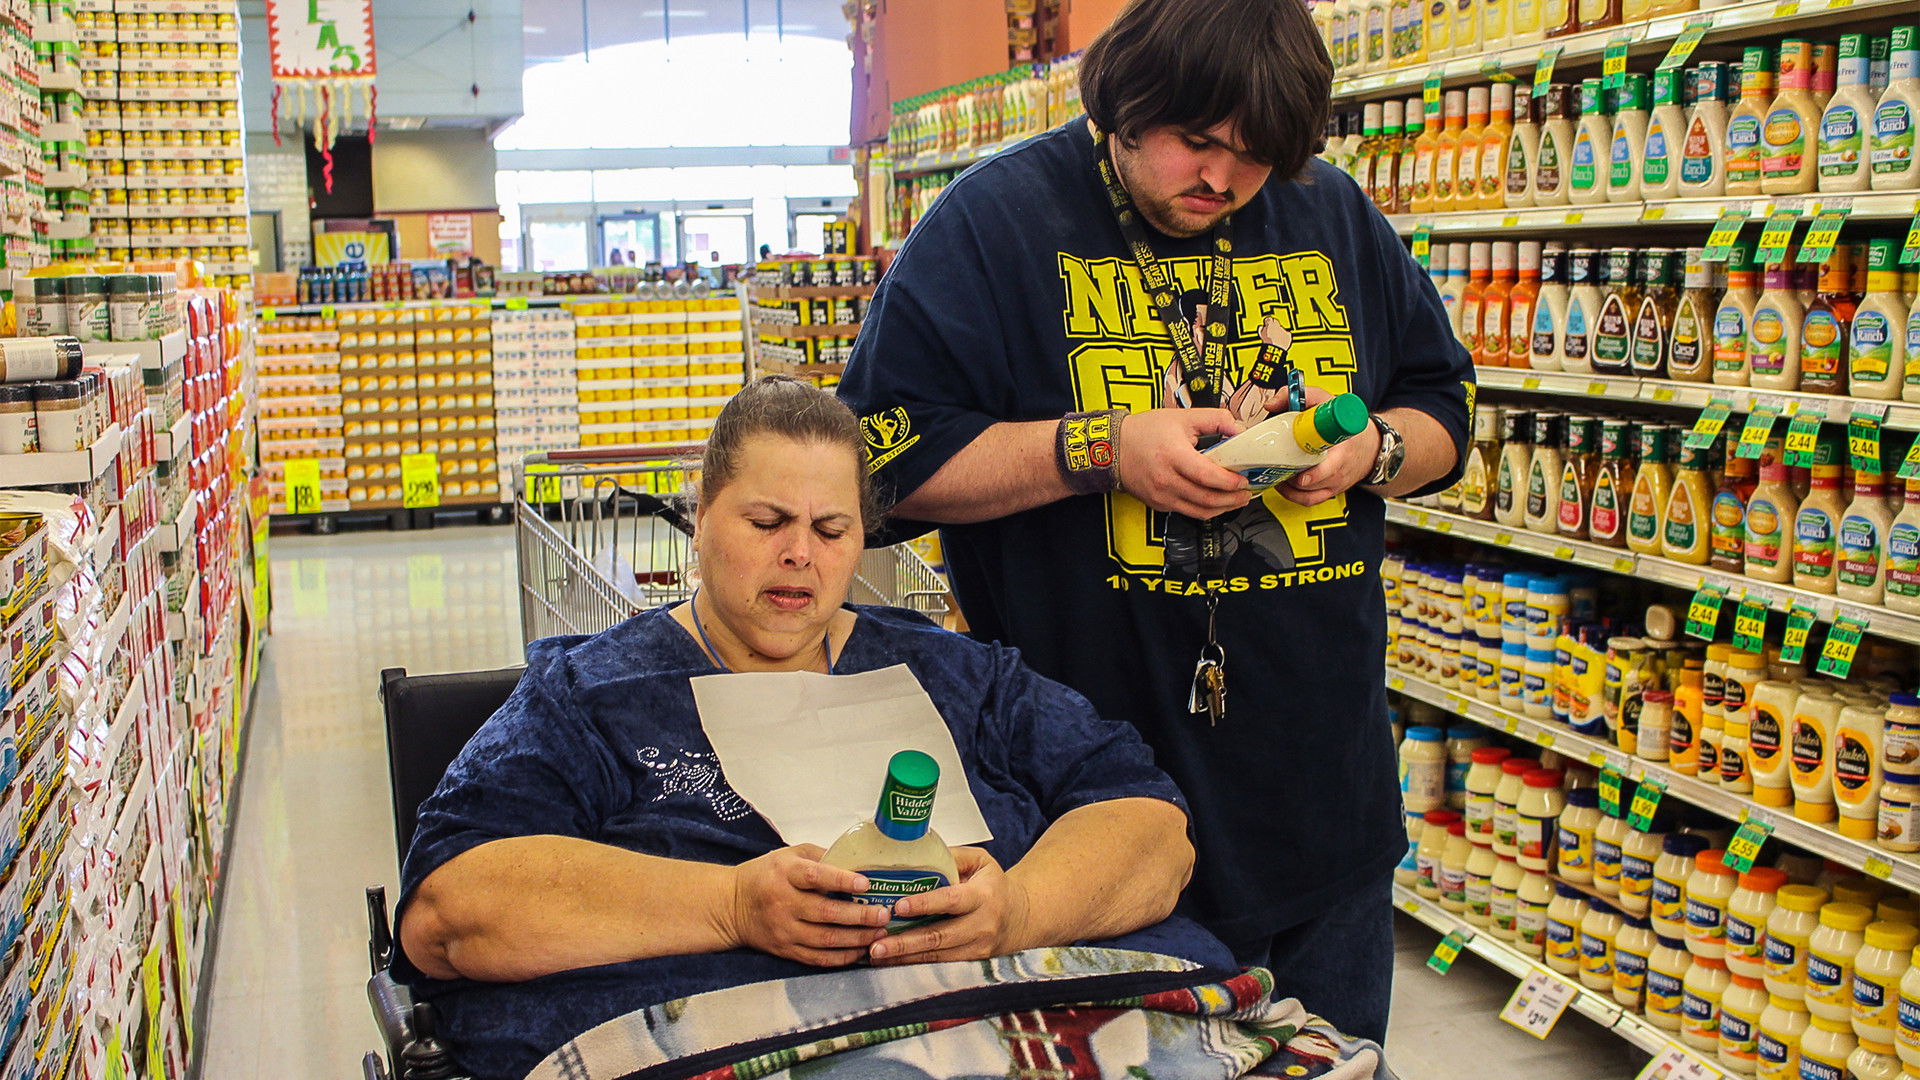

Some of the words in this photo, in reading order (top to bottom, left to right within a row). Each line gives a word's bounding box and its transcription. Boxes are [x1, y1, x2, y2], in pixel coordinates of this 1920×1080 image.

[1826, 123, 1853, 137] Ranch
[1879, 119, 1905, 132] Ranch
[1732, 131, 1756, 144] Ranch
[1711, 233, 1733, 245] 2.44
[1762, 233, 1785, 245] 2.44
[1806, 232, 1832, 245] 2.44
[1214, 254, 1225, 278] FEAR
[1149, 264, 1167, 288] FEAR
[1856, 329, 1884, 344] Ranch
[1204, 341, 1217, 370] FEAR
[1694, 420, 1719, 433] 2.44
[1741, 428, 1764, 441] 2.44
[1787, 434, 1811, 448] 2.44
[1065, 418, 1092, 471] ME
[1851, 439, 1874, 455] 2.44
[1799, 526, 1826, 539] Ranch
[1844, 532, 1870, 547] Ranch
[1802, 554, 1819, 563] SPICY
[1845, 561, 1865, 572] BACON
[1139, 576, 1251, 597] YEARS
[1259, 560, 1367, 590] STRONG
[1892, 570, 1912, 581] BACON
[1690, 604, 1713, 622] 2.44
[1737, 618, 1760, 635] 2.44
[1785, 629, 1804, 644] 2.44
[1825, 641, 1850, 659] 2.44
[1839, 746, 1867, 762] Duke's
[896, 796, 933, 808] Hidden
[1635, 798, 1653, 816] 1.99
[896, 806, 930, 817] Valley
[1730, 838, 1755, 857] 2.55
[901, 883, 932, 892] Valley
